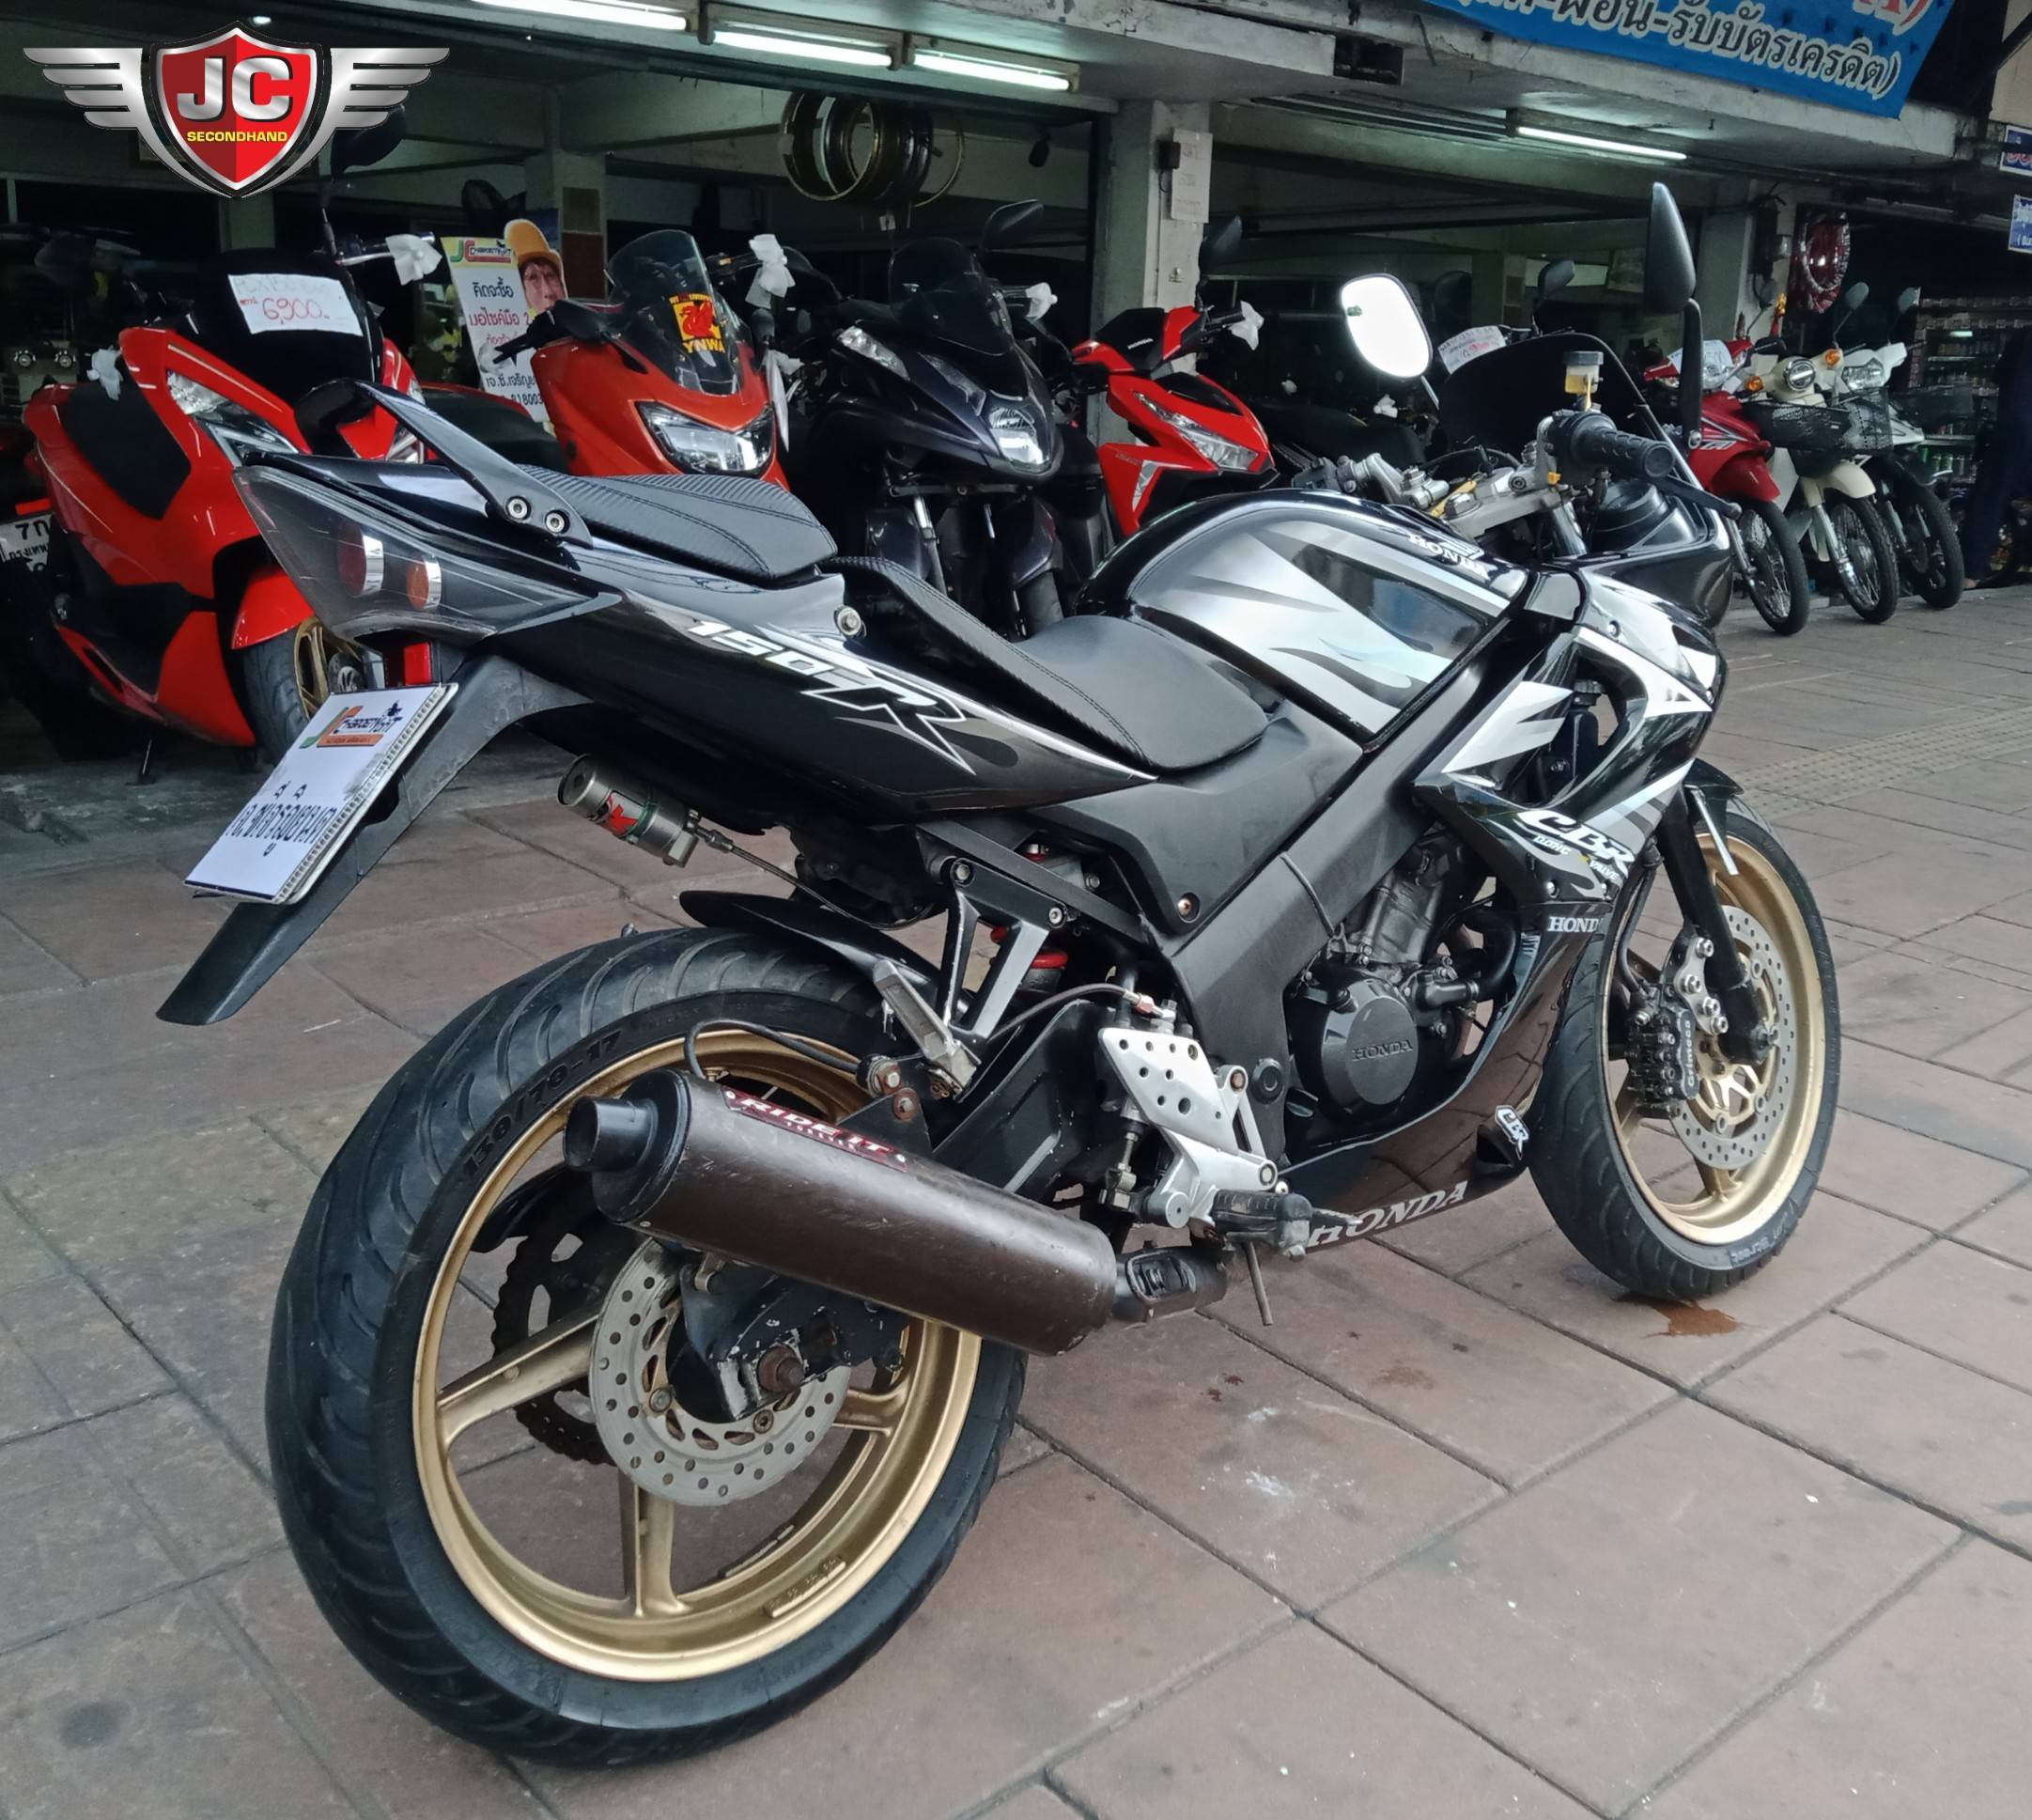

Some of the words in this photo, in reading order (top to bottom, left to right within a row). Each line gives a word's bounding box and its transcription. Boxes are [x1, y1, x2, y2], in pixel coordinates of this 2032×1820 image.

[1405, 531, 1491, 581] HONDA
[1517, 809, 1636, 879] CBR
[1590, 858, 1621, 881] VALVE
[1547, 915, 1603, 933] HOND
[1352, 1039, 1414, 1062] HONDA
[1683, 1019, 1696, 1088] Grimeca
[739, 1097, 843, 1136] RIDE
[847, 1134, 891, 1153] IT
[1497, 1107, 1529, 1155] CBR
[1307, 1179, 1469, 1248] HONDA
